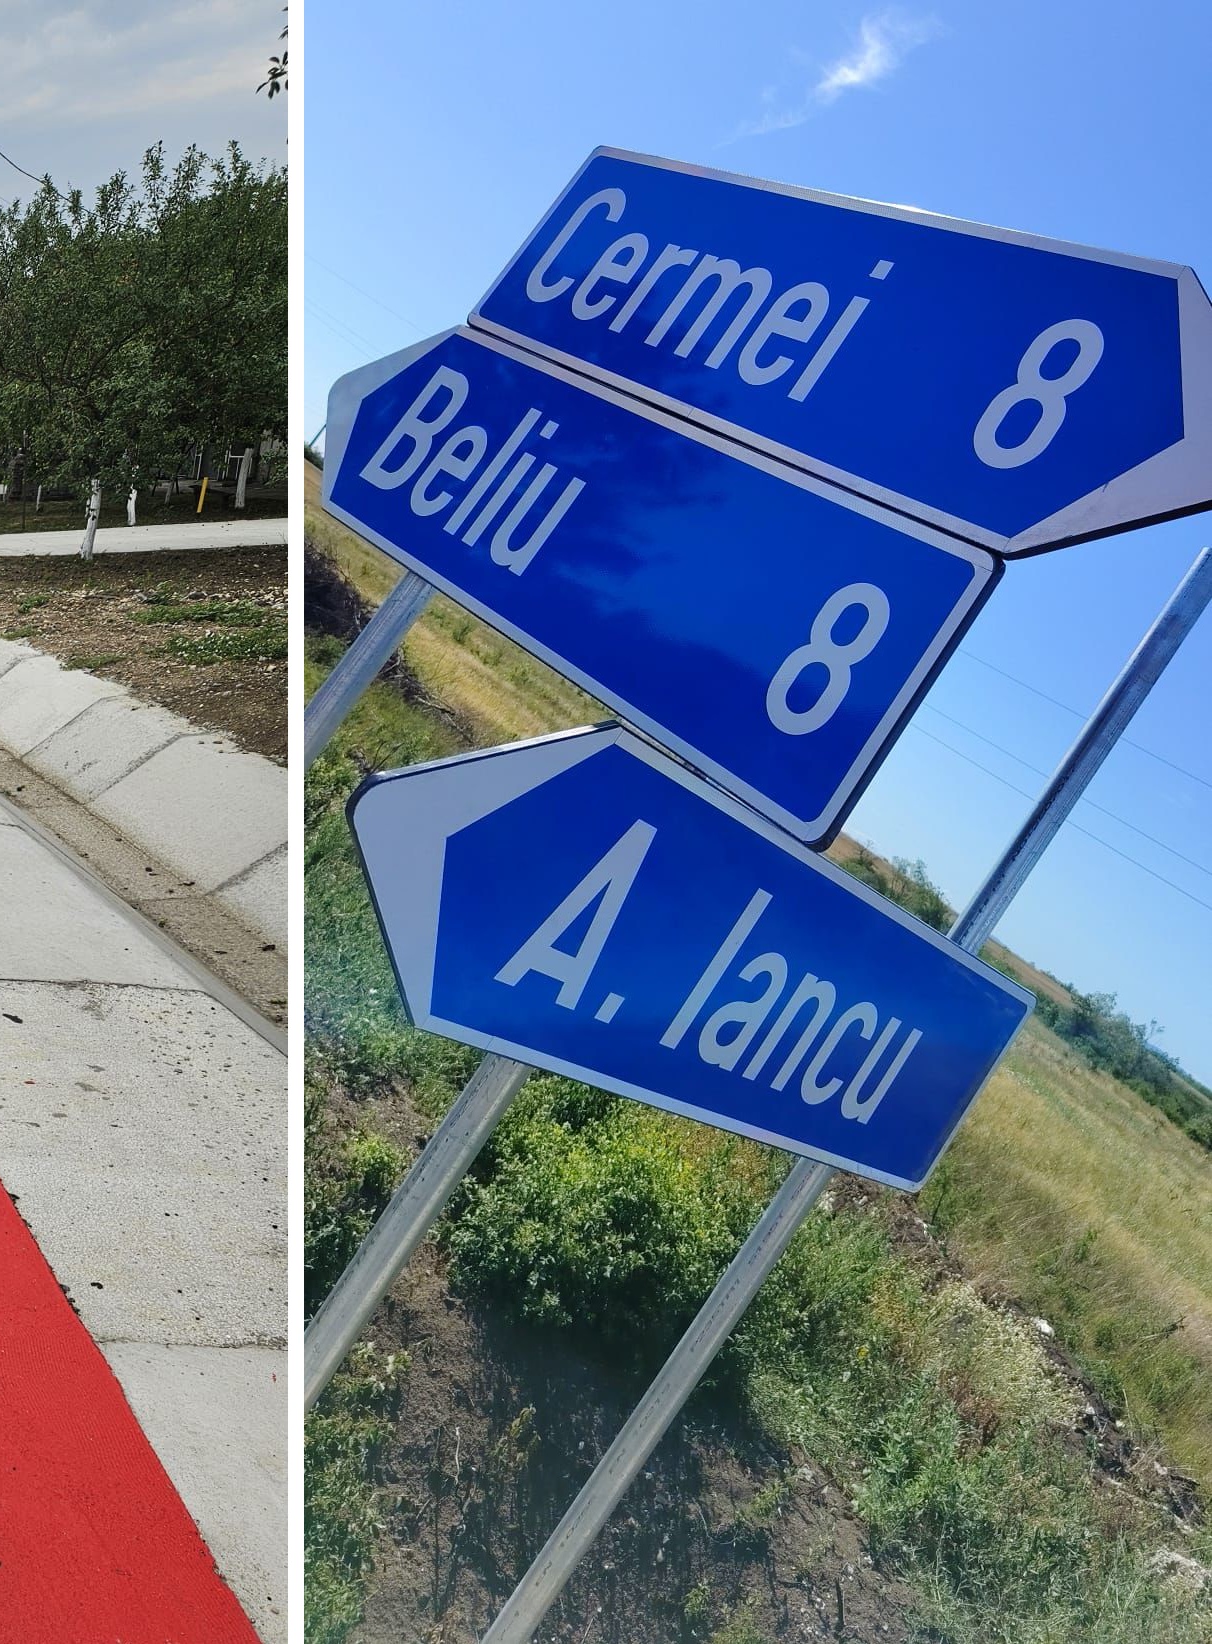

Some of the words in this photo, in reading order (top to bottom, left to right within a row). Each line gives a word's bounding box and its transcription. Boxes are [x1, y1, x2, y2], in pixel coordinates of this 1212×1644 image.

[526, 188, 895, 402] Cermei
[973, 318, 1105, 469] 8
[359, 365, 587, 577] Beliu
[765, 582, 891, 736] 8
[493, 818, 658, 1024] A.
[659, 887, 924, 1125] Iancu
